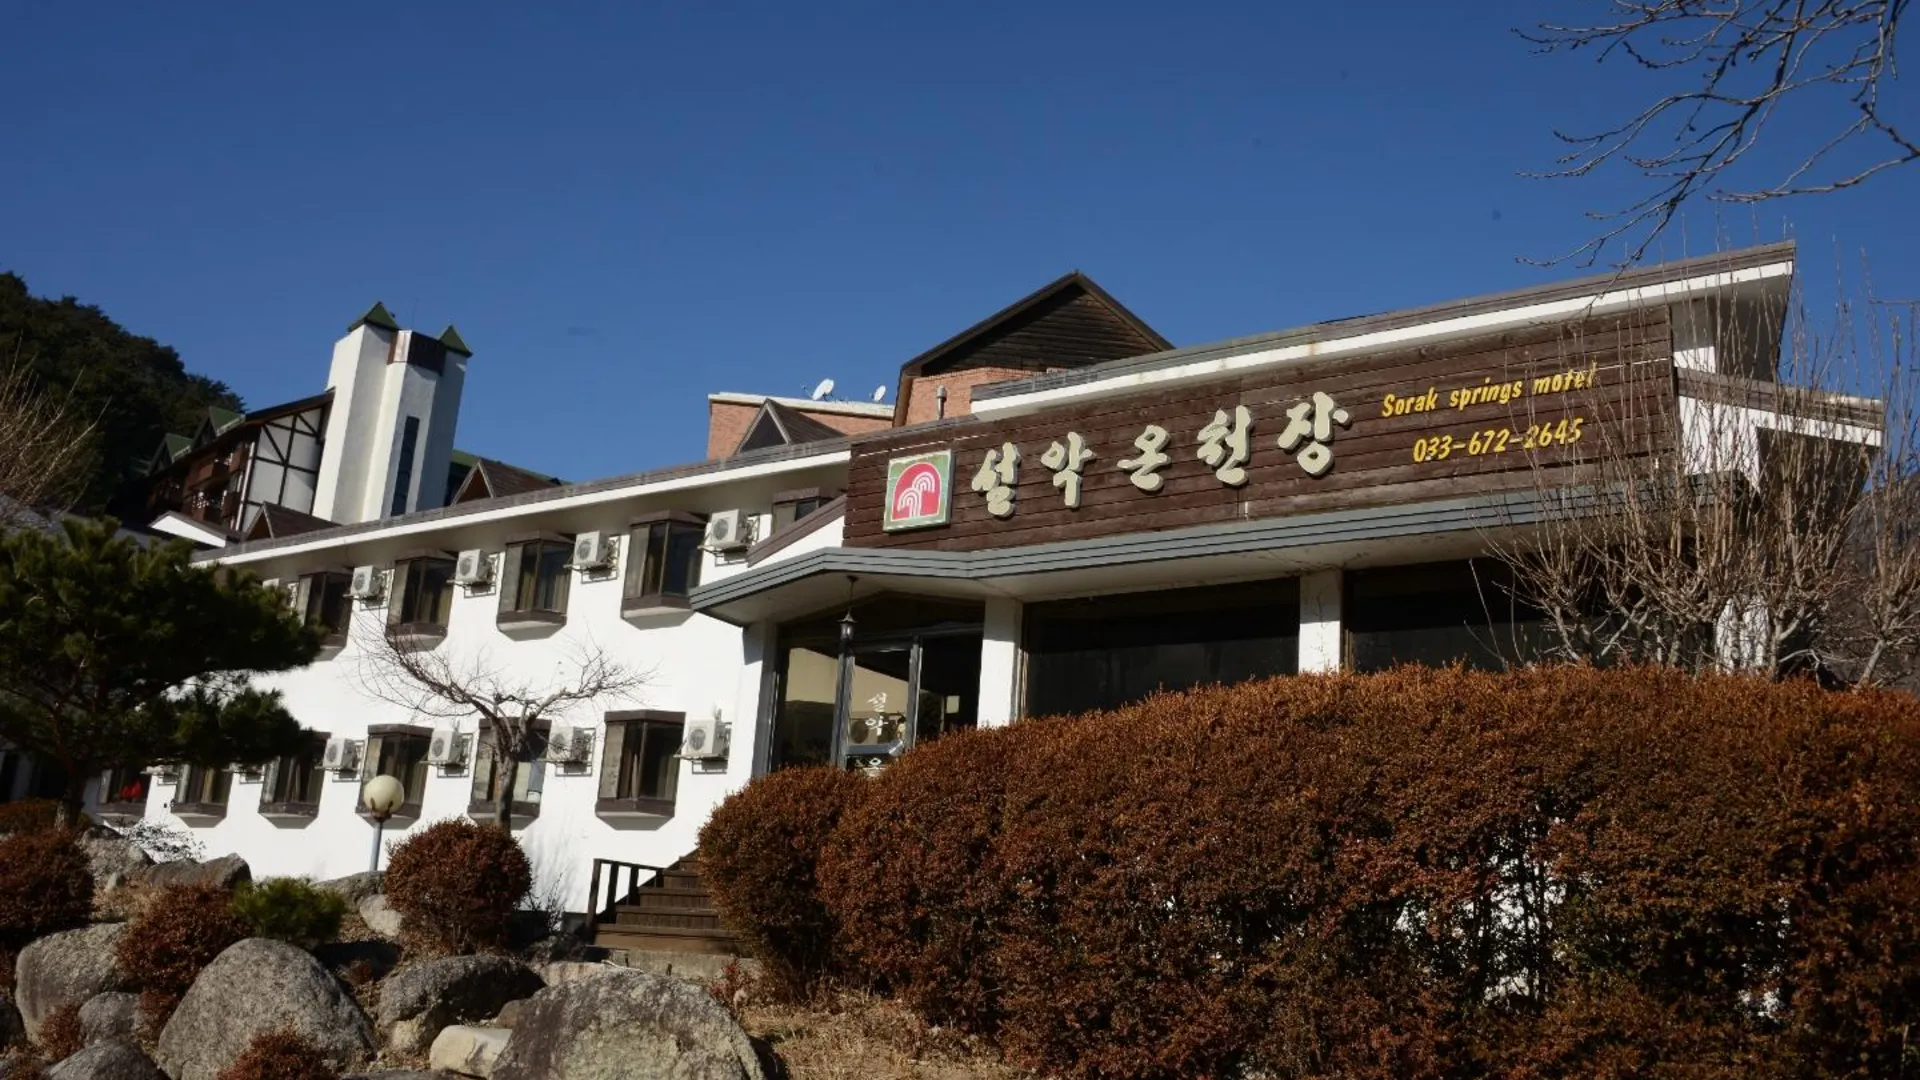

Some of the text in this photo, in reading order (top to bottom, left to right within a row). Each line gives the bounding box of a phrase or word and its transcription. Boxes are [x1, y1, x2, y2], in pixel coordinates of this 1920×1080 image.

[1381, 359, 1598, 417] Sorak springs motel
[1412, 418, 1584, 462] 033-672-2645
